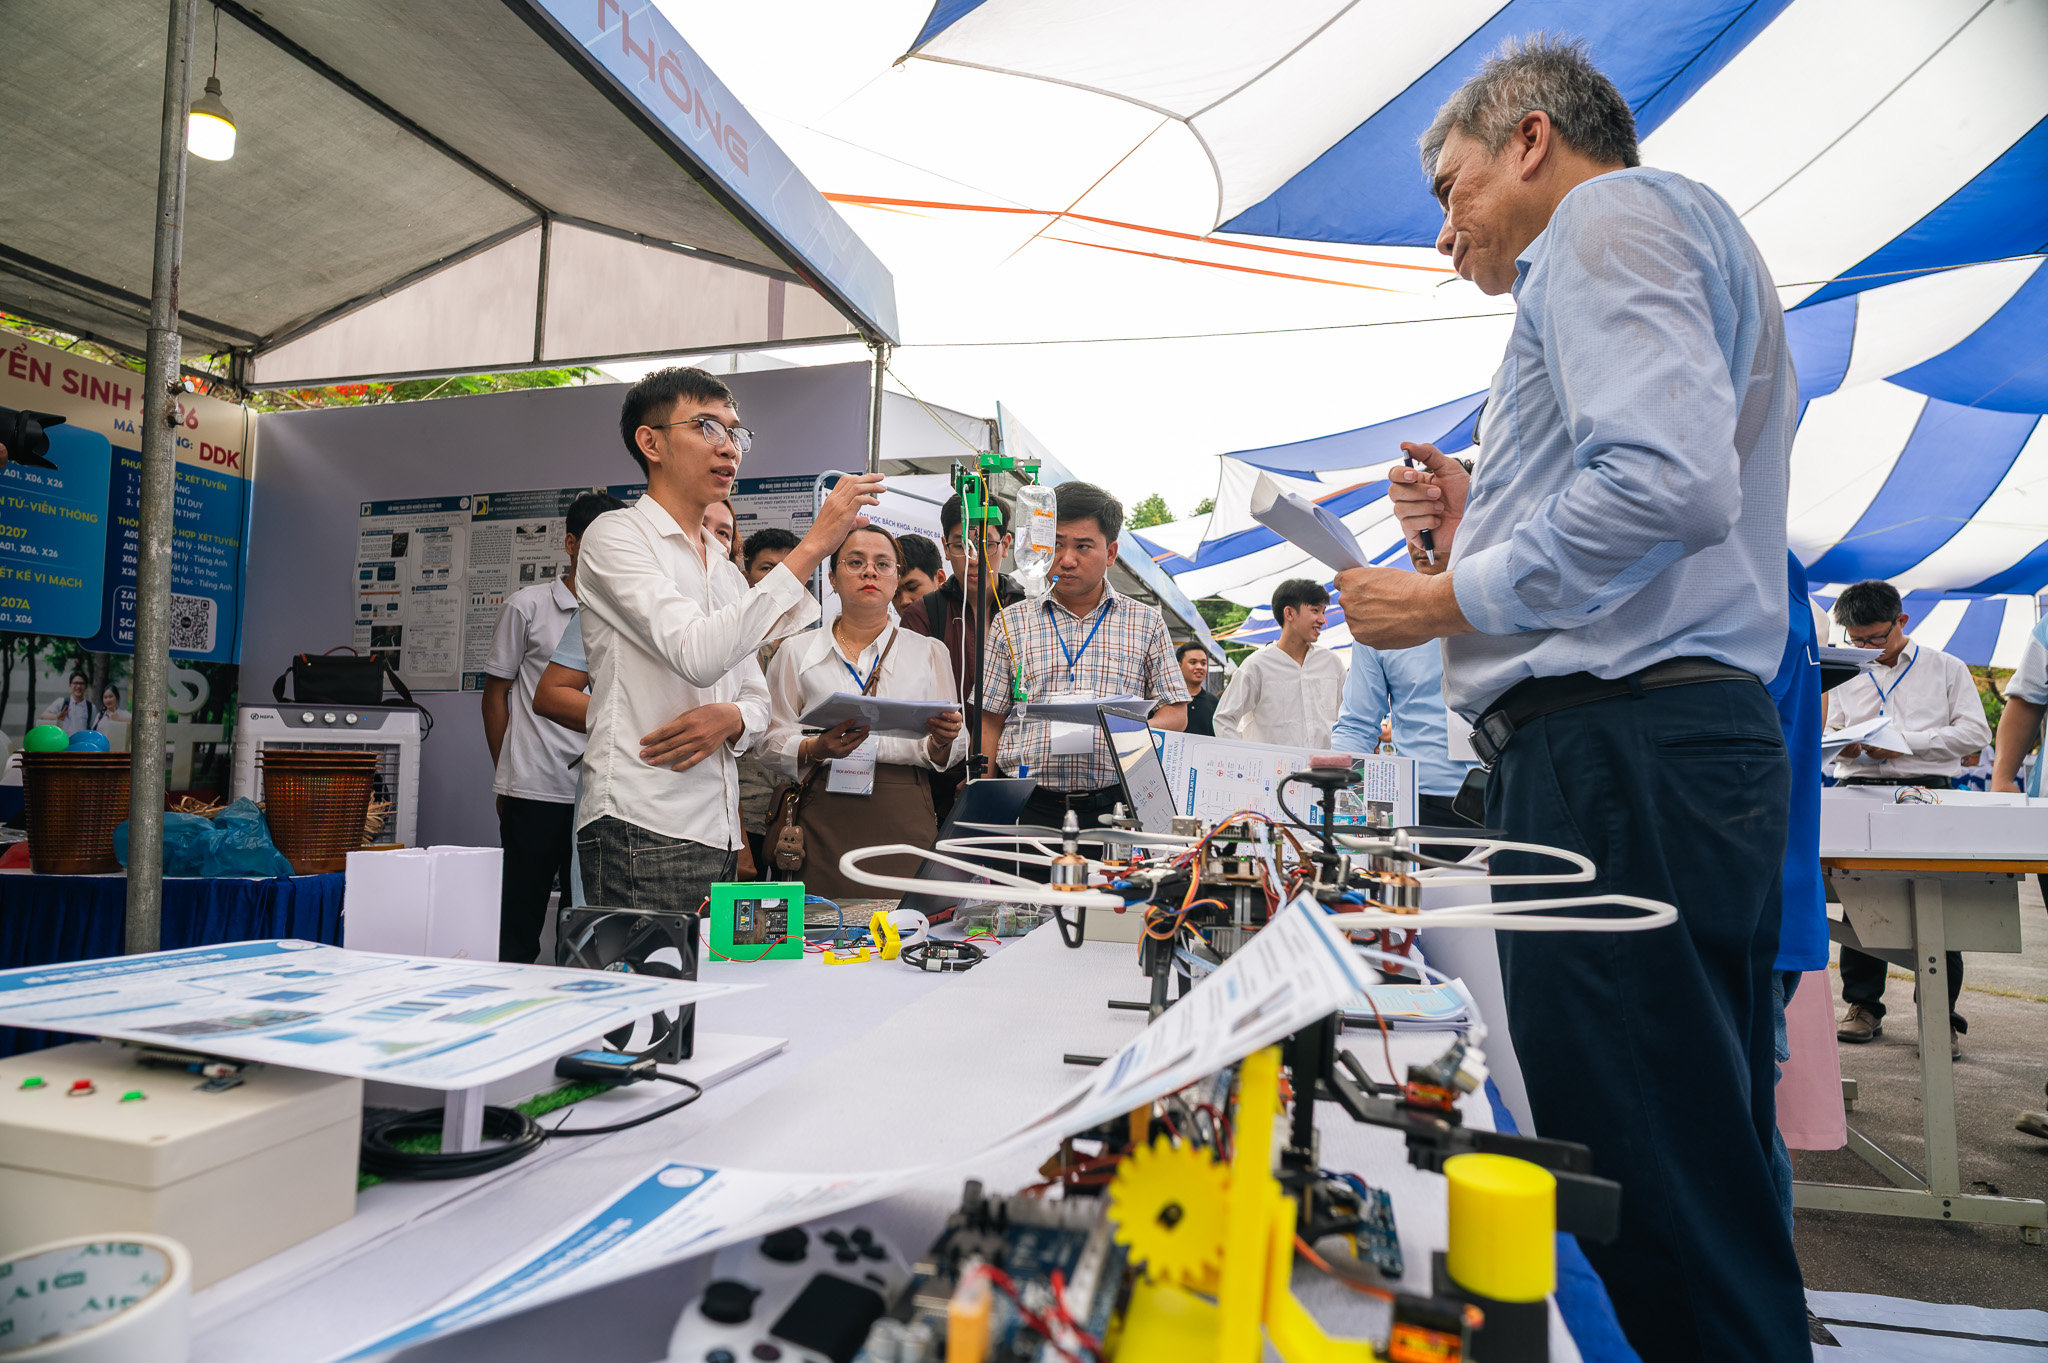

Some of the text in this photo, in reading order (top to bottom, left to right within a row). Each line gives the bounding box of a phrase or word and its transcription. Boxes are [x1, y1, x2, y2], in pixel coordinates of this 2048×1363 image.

[61, 368, 131, 411] SINH
[114, 418, 135, 434] MÃ
[199, 441, 240, 470] DDK
[59, 505, 98, 523] THÔNG
[882, 518, 896, 527] BÁCH
[896, 522, 910, 531] KHOA
[49, 575, 82, 588] MẠCH
[0, 596, 30, 609] 207A
[118, 631, 133, 640] ME
